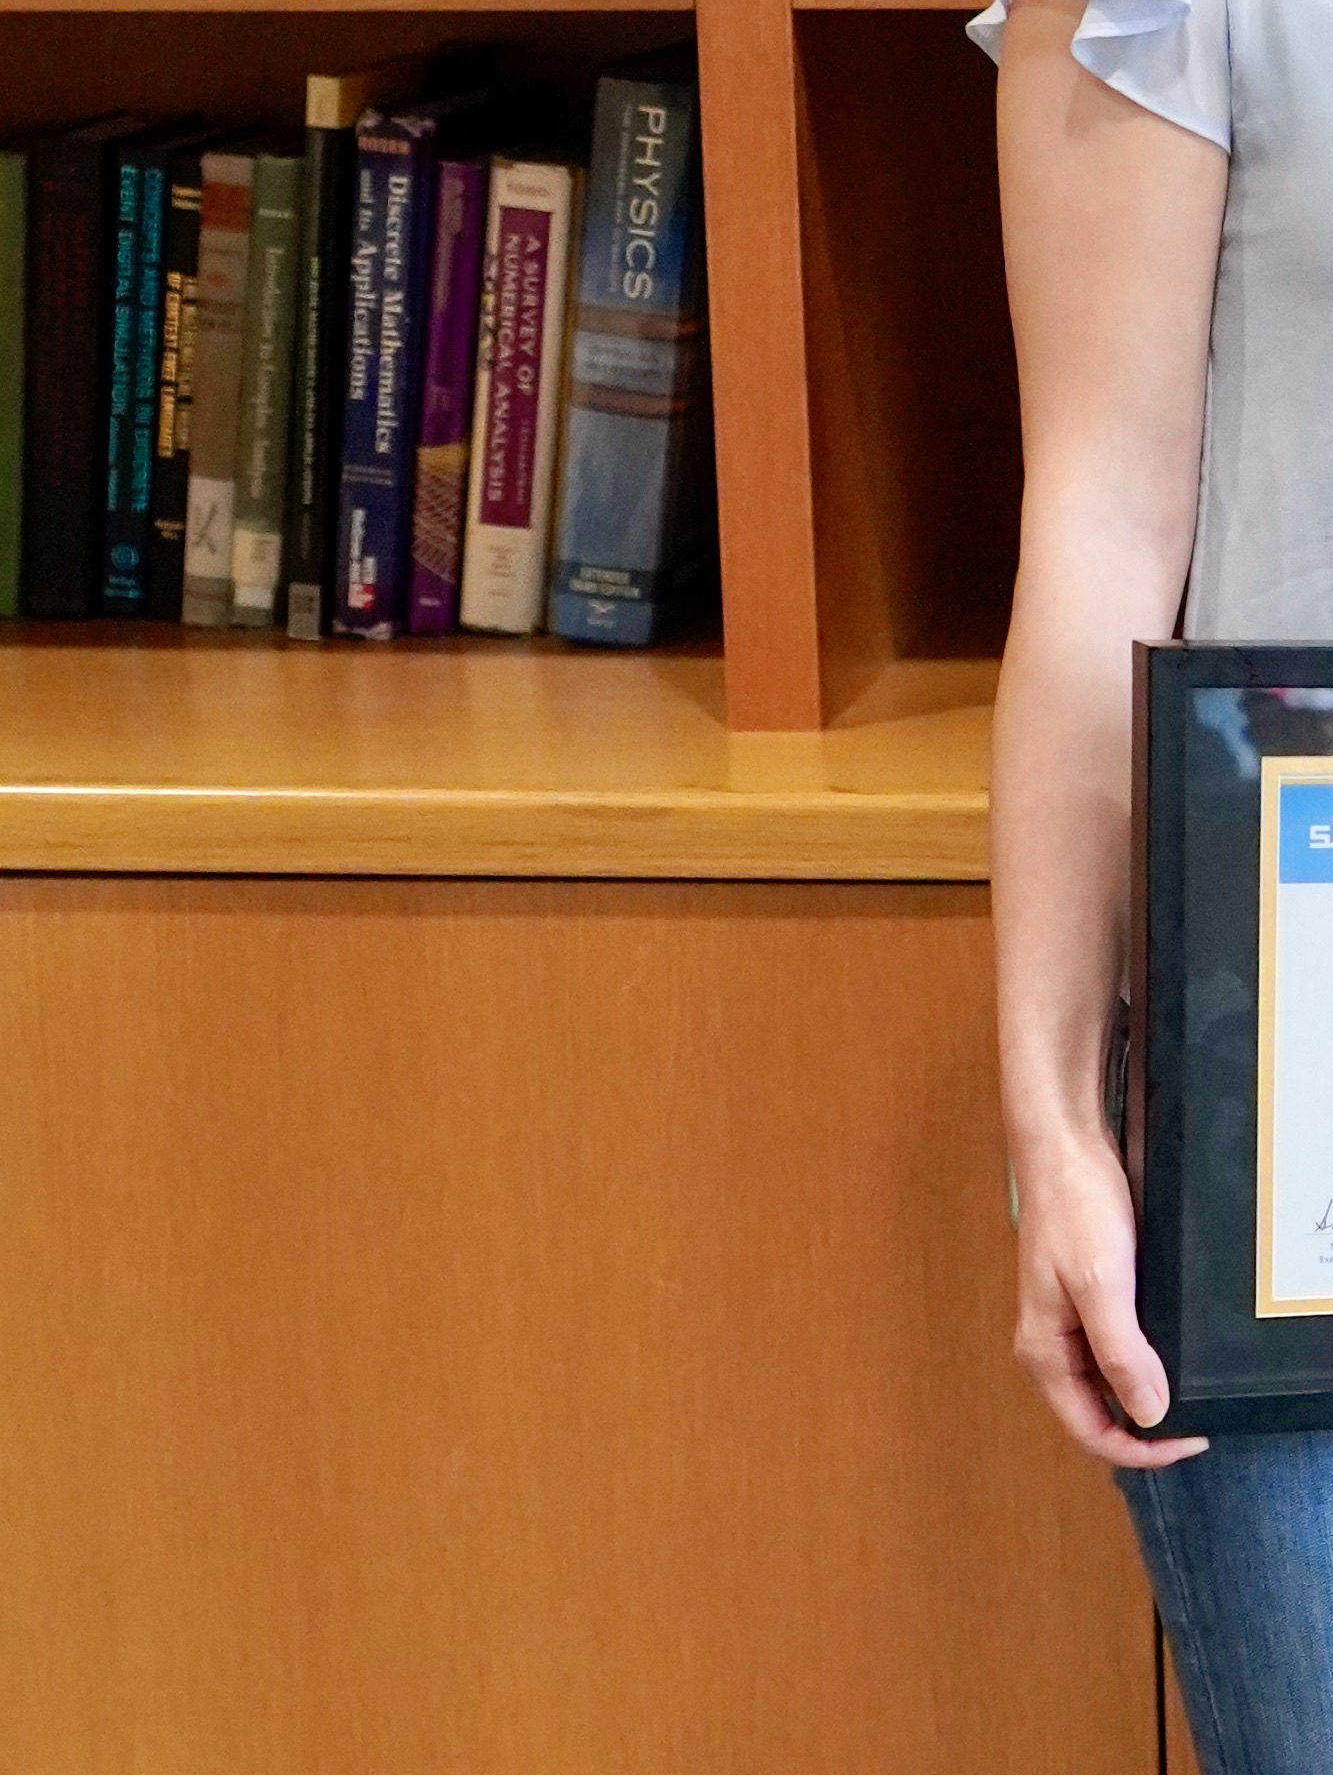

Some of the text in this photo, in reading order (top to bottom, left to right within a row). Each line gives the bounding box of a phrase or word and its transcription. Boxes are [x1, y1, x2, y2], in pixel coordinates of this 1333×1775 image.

[116, 230, 134, 297] DIGITAL
[360, 169, 374, 203] and
[623, 107, 667, 300] PHYSICS
[112, 305, 132, 414] SIMULATION
[141, 268, 158, 306] AND
[350, 242, 378, 399] Applications
[375, 175, 408, 453] Discrete Mathematics
[517, 234, 541, 396] A SURVEY OF
[488, 233, 519, 502] NUMERICAL ANALYSIS
